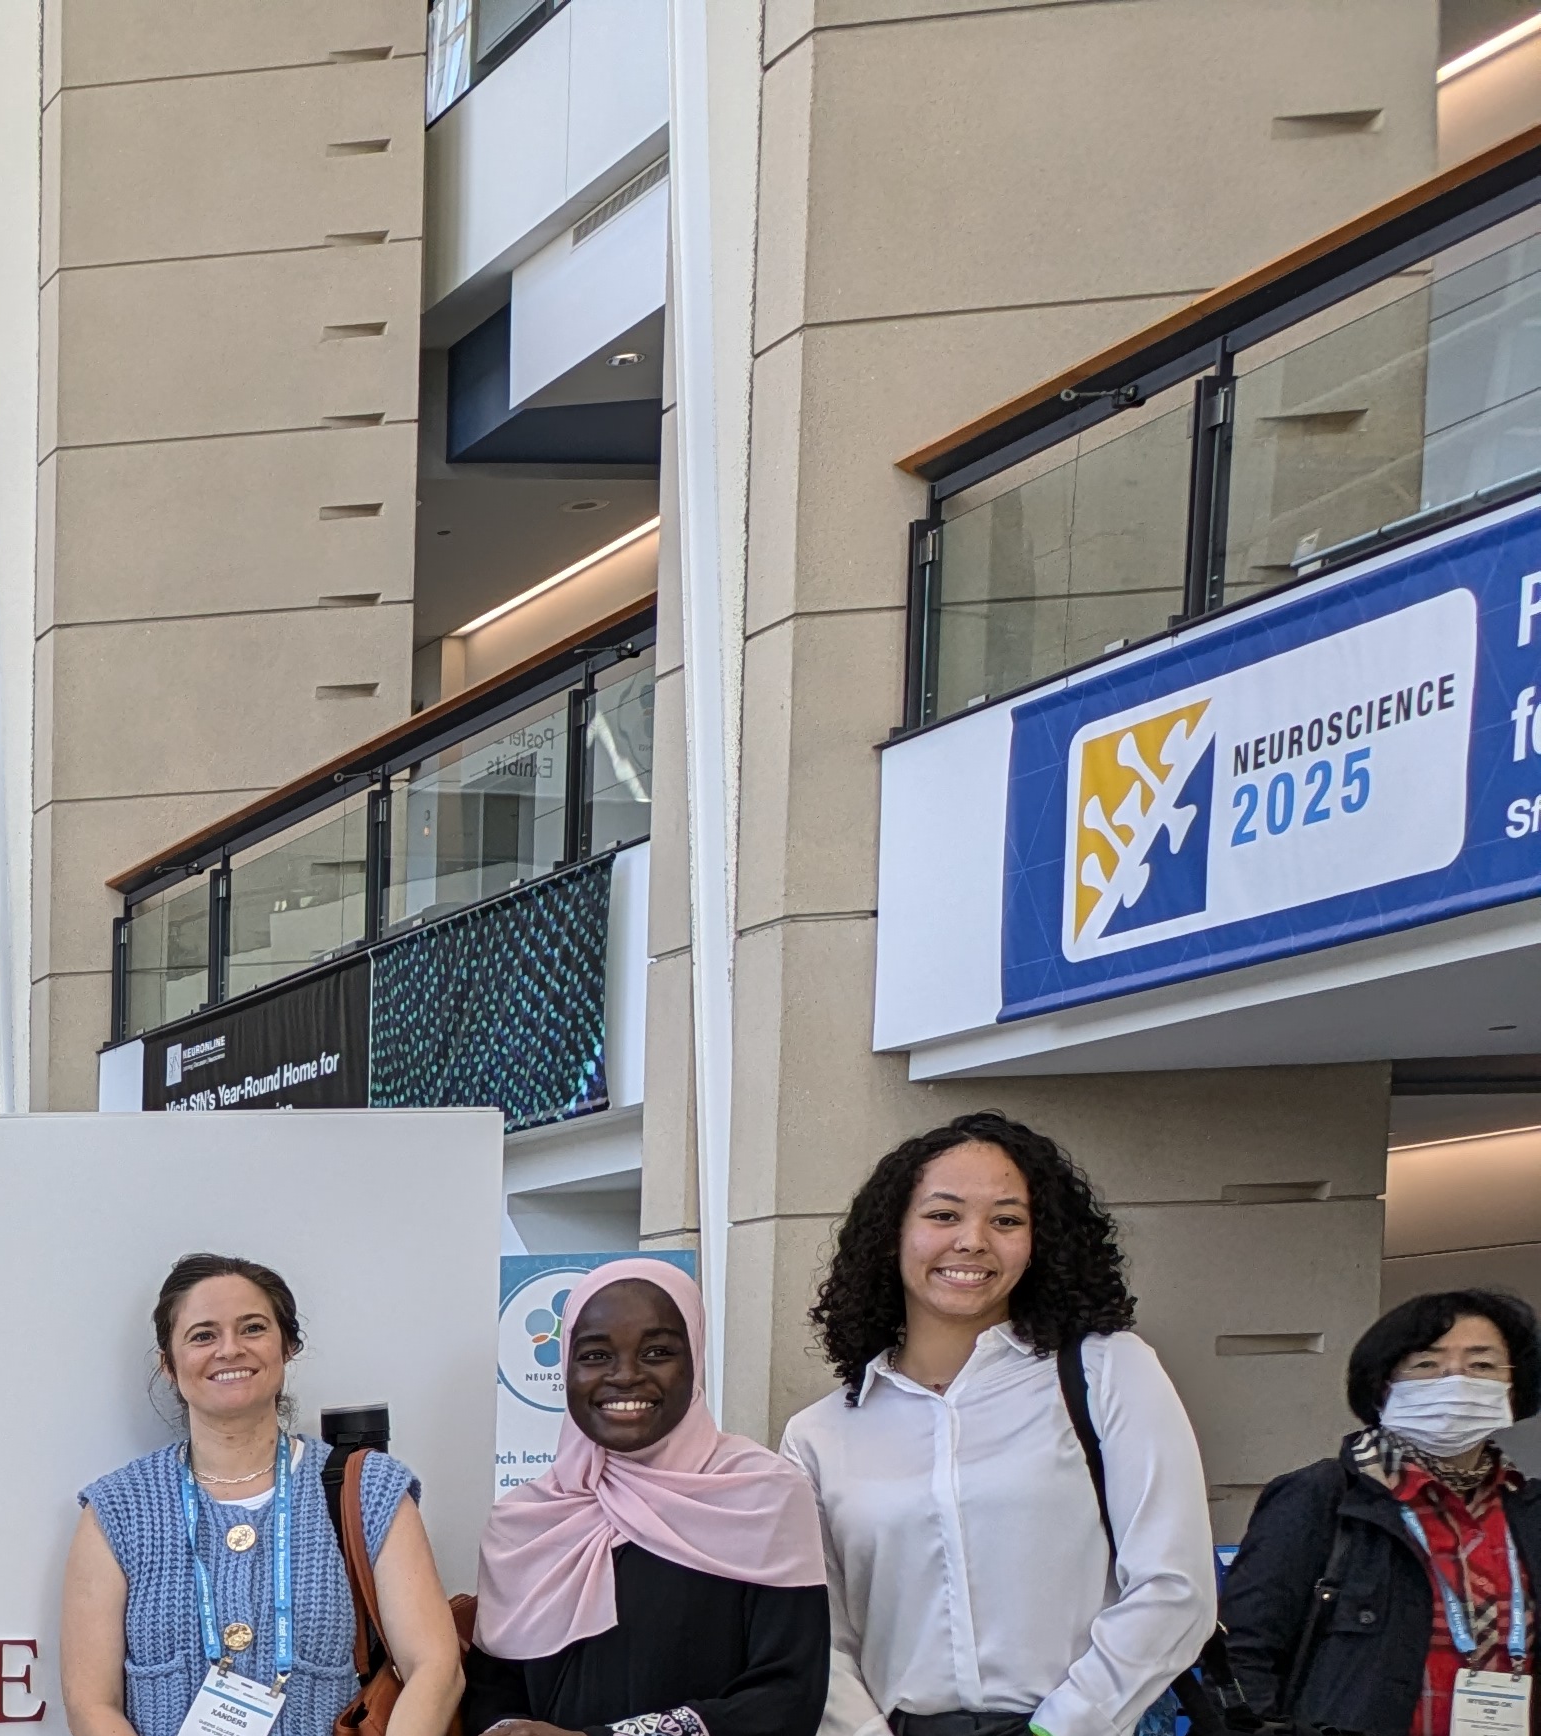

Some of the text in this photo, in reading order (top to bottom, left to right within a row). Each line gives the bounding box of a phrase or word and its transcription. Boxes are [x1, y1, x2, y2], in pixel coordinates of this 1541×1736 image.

[1232, 672, 1456, 777] NEUROSCIENCE
[1229, 746, 1373, 848] 2025
[218, 1065, 281, 1108] Year-Round
[283, 1058, 318, 1088] Home
[319, 1052, 340, 1076] for
[525, 1373, 562, 1382] NEURO
[522, 1450, 558, 1464] lectu
